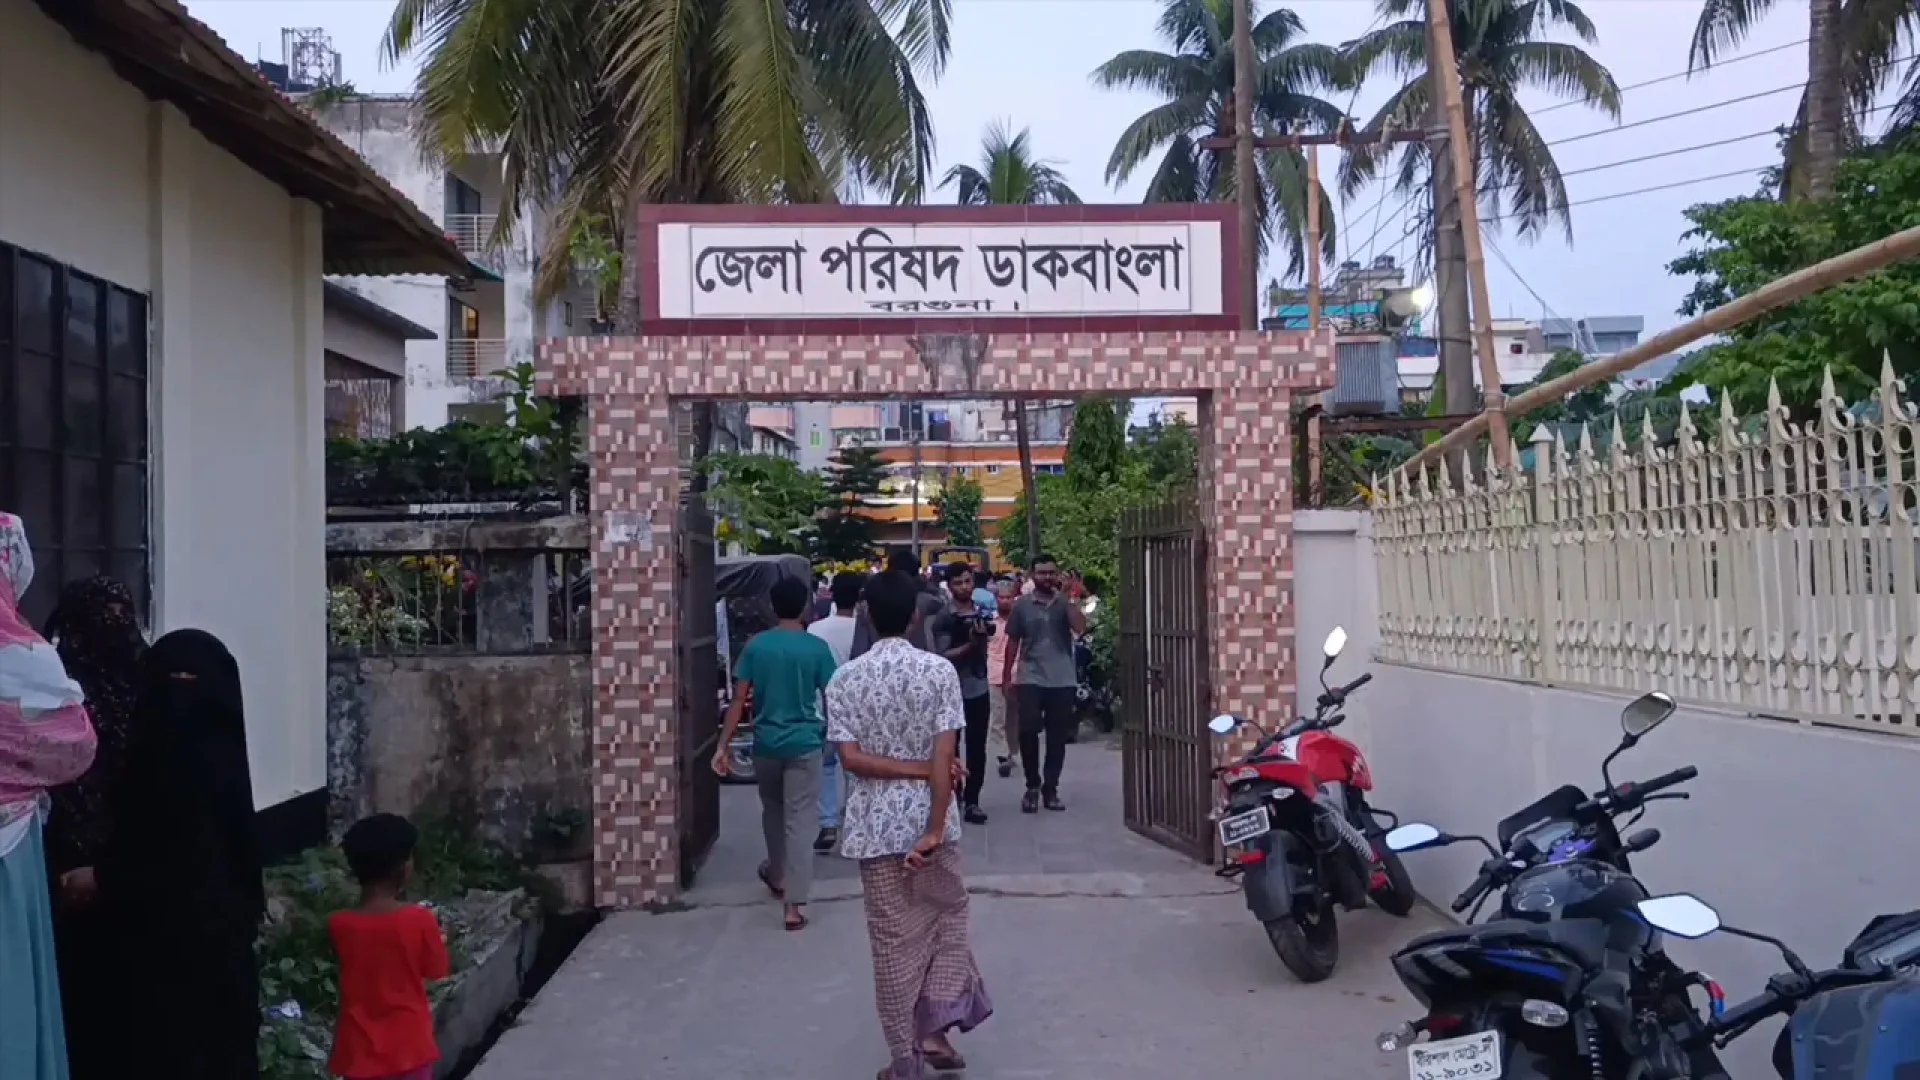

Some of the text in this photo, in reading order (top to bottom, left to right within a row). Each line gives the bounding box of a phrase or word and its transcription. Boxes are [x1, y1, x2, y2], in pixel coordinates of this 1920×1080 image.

[695, 227, 1186, 294] জেলা পরিষদ ডাকবাংলা
[864, 299, 996, 312] বরগুনা
